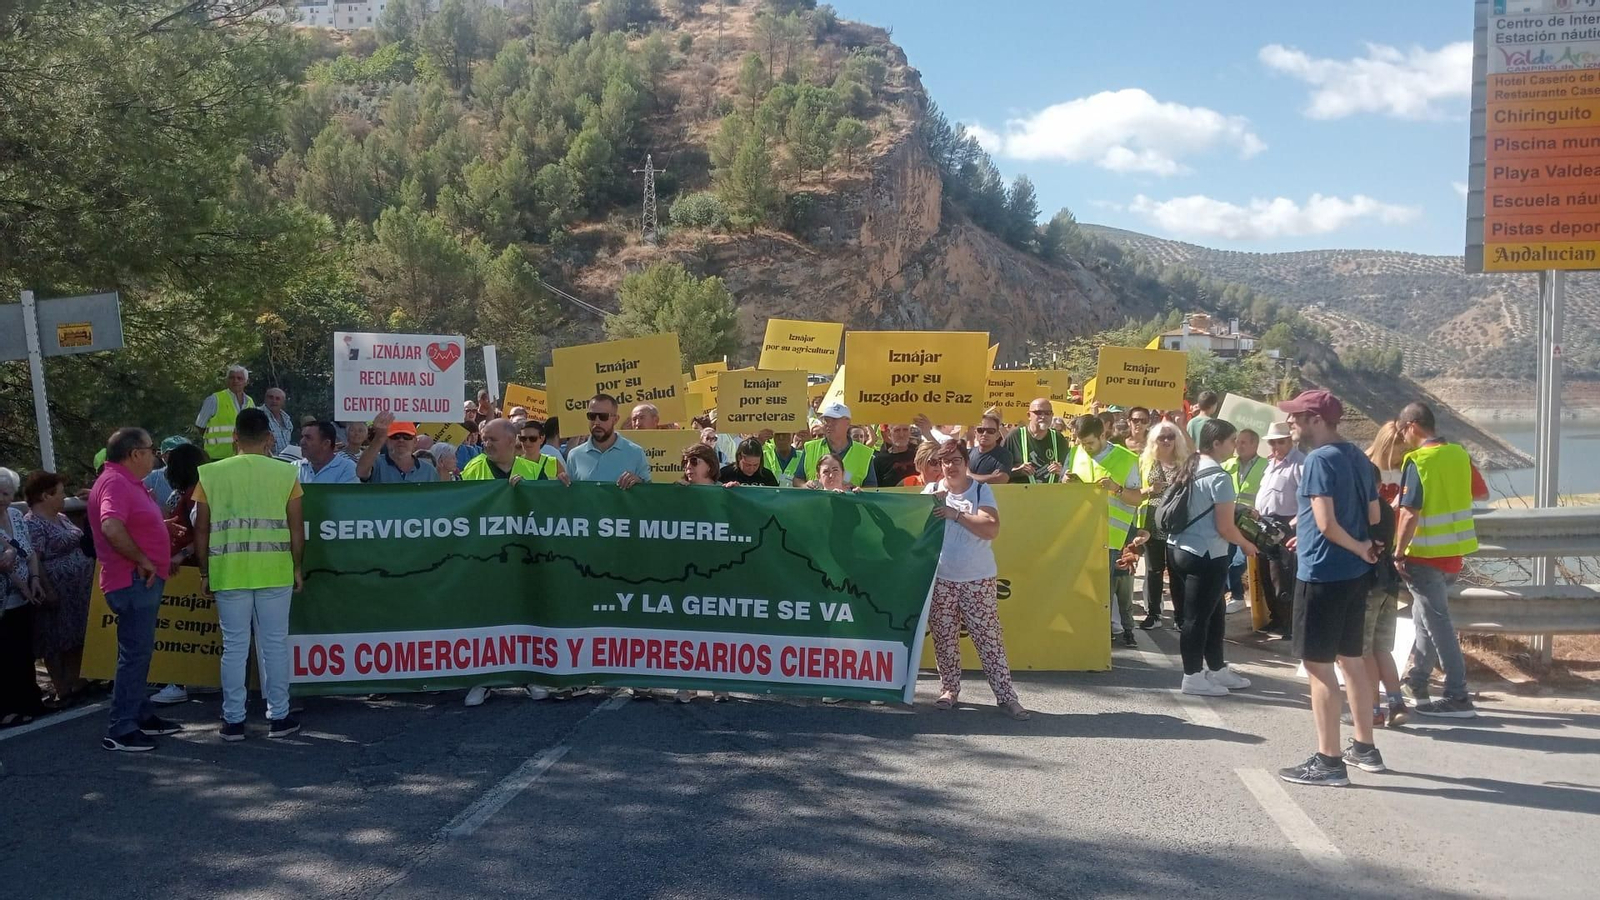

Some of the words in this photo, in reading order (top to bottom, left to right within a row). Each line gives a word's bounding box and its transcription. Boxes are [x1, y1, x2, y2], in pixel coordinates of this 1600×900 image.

[1496, 18, 1543, 30] Centro
[1548, 16, 1565, 27] de
[1496, 30, 1556, 44] Estación
[1495, 76, 1526, 87] Hotel
[1579, 73, 1595, 83] de
[1495, 88, 1567, 100] Restaurante
[1494, 106, 1592, 125] Chiringuito
[1494, 136, 1556, 151] Piscina
[1493, 166, 1540, 183] Playa
[1492, 193, 1560, 208] Escuela
[1566, 191, 1600, 206] náu
[1492, 222, 1544, 236] Pistas
[1492, 246, 1596, 264] Andalucian
[373, 342, 421, 360] IZNÁJAR
[791, 346, 835, 355] agricultura
[888, 349, 943, 367] Iznájar
[596, 358, 640, 374] Iznájar
[1123, 362, 1160, 375] Iznájar
[360, 371, 416, 386] RECLAMA
[420, 372, 434, 387] SU
[596, 379, 621, 395] por
[625, 376, 642, 388] su
[744, 378, 782, 391] Iznájar
[891, 373, 920, 387] por
[923, 373, 941, 384] su
[1106, 376, 1125, 385] por
[1127, 377, 1140, 386] su
[1142, 377, 1176, 388] futuro
[636, 385, 676, 402] Salud
[858, 390, 919, 406] Juzgado
[923, 390, 941, 403] de
[945, 390, 973, 404] Paz
[344, 397, 390, 412] CENTRO
[394, 398, 409, 412] DE
[416, 399, 450, 413] SALUD
[740, 396, 763, 408] por
[765, 396, 787, 405] sus
[1016, 400, 1030, 408] Paz
[727, 412, 796, 422] carreteras
[645, 447, 667, 459] ájar
[320, 517, 470, 541] SERVICIOS
[479, 511, 590, 537] IZNÁJAR
[597, 518, 631, 538] SE
[639, 519, 753, 543] MUERE...
[160, 593, 216, 612] znájar
[642, 594, 673, 614] LA
[682, 597, 770, 618] GENTE
[777, 599, 812, 621] SE
[821, 602, 855, 623] VA
[154, 640, 224, 656] omercio
[293, 644, 345, 676] LOS
[354, 634, 559, 675] COMERCIANTES
[566, 638, 584, 668] Y
[592, 636, 772, 675] EMPRESARIOS
[780, 646, 894, 683] CIERRAN
